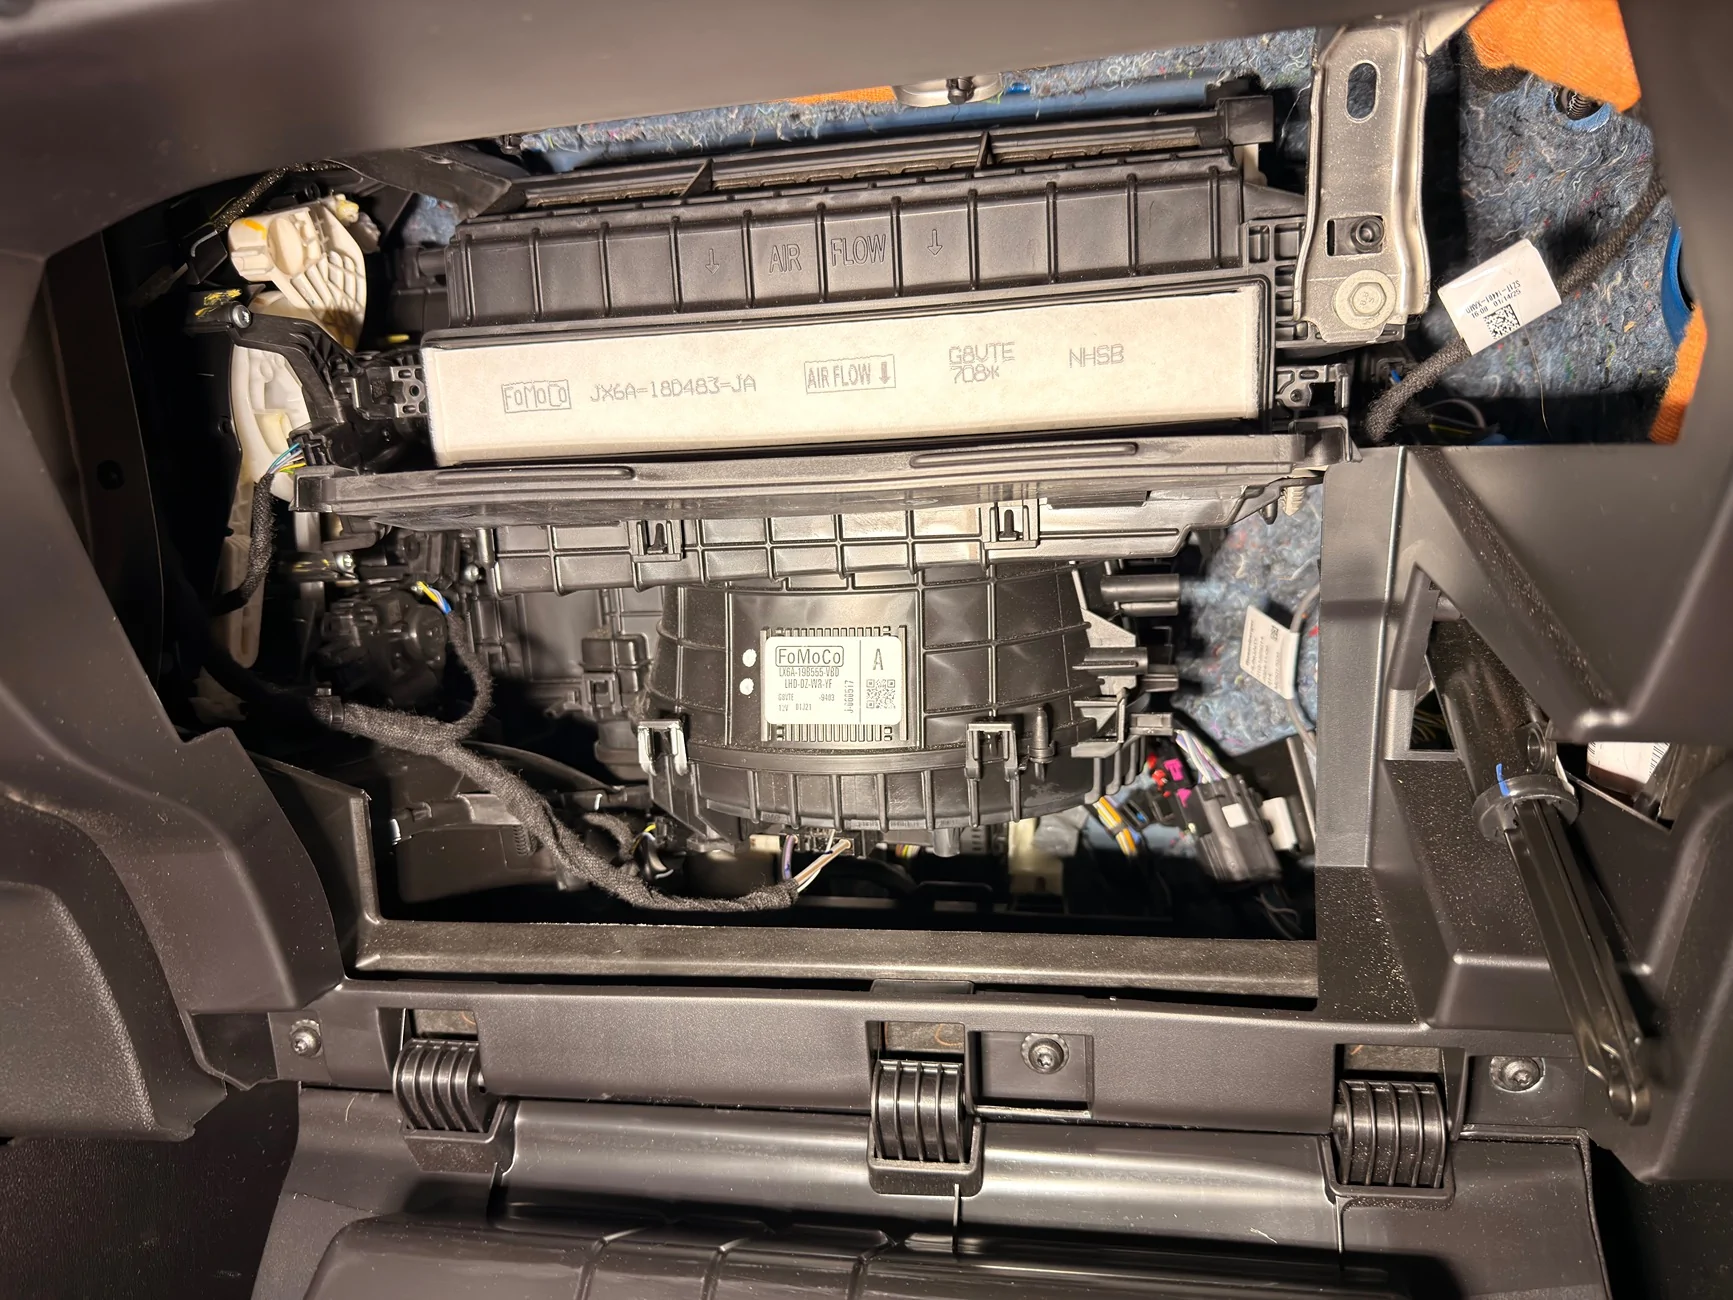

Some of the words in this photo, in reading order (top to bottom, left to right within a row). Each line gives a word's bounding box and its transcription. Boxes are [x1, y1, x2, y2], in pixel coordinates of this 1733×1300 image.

[769, 244, 802, 273] AIR
[831, 234, 886, 266] FLOW
[1069, 343, 1125, 367] NHSB
[807, 366, 830, 389] AIR
[833, 362, 872, 387] FLOW
[503, 384, 567, 410] FoMoCo
[779, 648, 841, 665] FoMoCo
[872, 648, 884, 671] A
